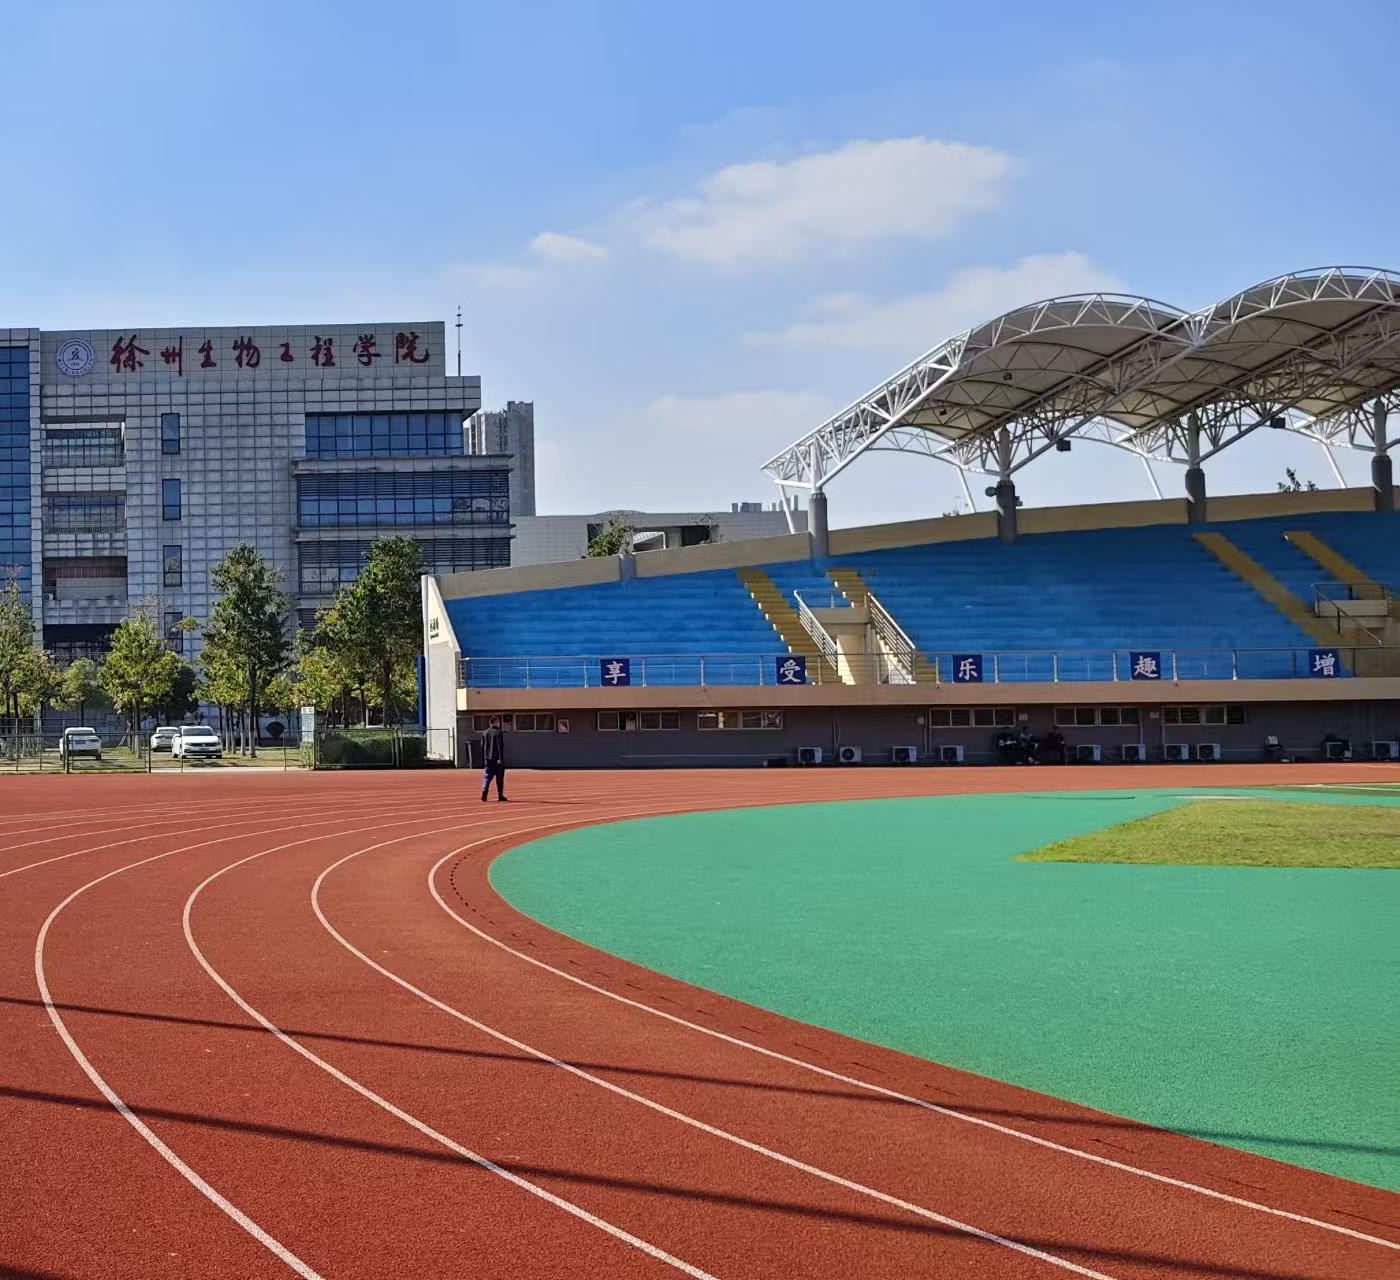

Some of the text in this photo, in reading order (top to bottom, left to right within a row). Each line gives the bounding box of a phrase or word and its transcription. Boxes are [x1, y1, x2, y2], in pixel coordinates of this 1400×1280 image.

[110, 332, 430, 376] 徐州生物工程学院
[604, 652, 1335, 685] 享 受 乐 趣 增
